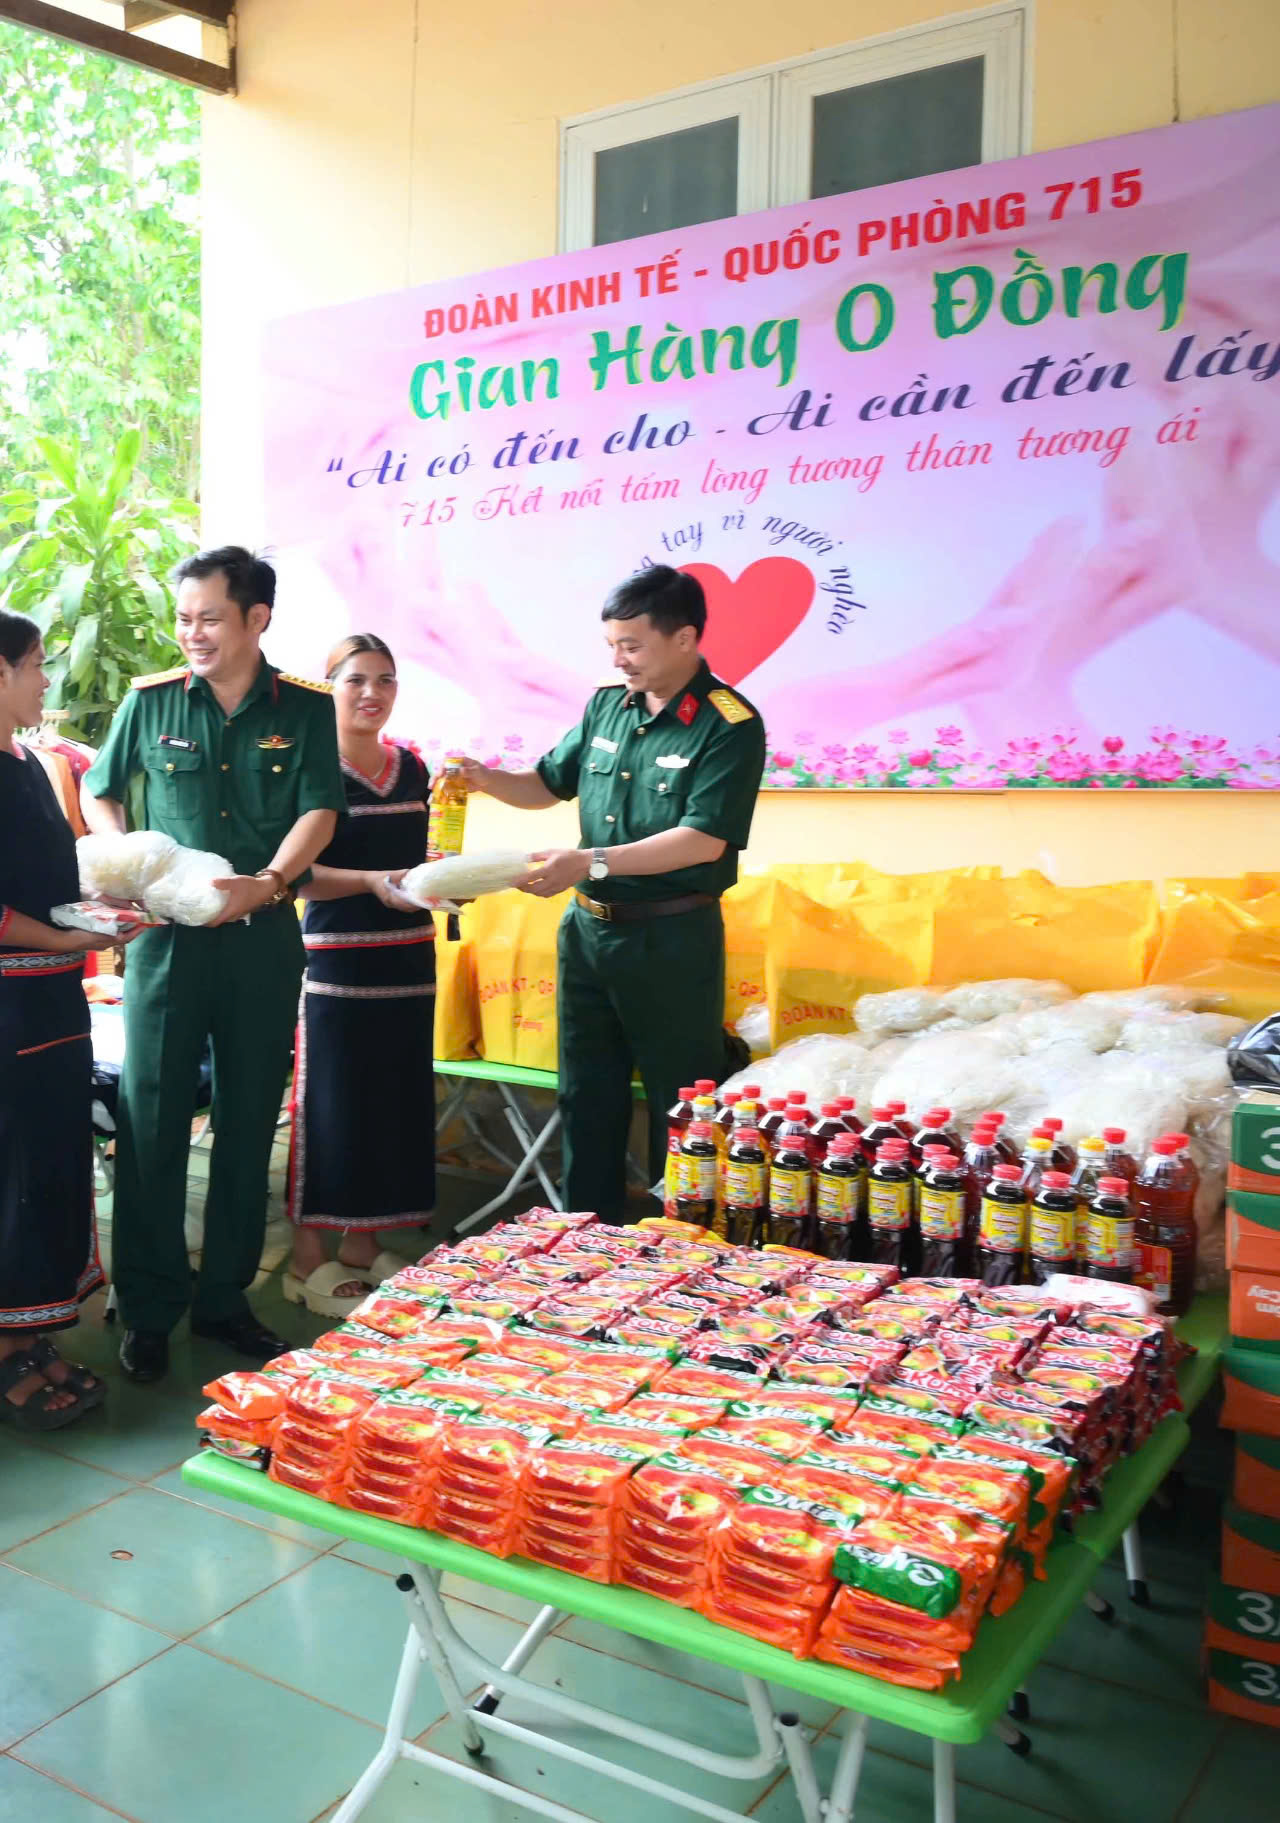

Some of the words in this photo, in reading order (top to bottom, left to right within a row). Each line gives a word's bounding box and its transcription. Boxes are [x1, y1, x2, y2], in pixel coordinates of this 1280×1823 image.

[424, 293, 519, 338] ĐOÀN
[531, 271, 621, 319] KINH
[634, 248, 683, 298] TẾ
[724, 222, 841, 283] QUỐC
[858, 191, 1027, 257] PHÒNG
[1044, 168, 1143, 221] 715
[409, 355, 561, 421] Gian
[589, 318, 800, 391] Hàng
[932, 248, 1190, 339] Đồng
[427, 443, 477, 479] có
[492, 431, 584, 469] đến
[604, 413, 696, 455] cho
[747, 388, 837, 435] Ai
[858, 374, 977, 422] cần
[1001, 352, 1137, 403] đến
[1164, 329, 1280, 382] lấy
[400, 497, 458, 527] 715
[701, 458, 770, 504] lòng
[906, 433, 993, 473] thân
[1017, 420, 1131, 468] tương
[1156, 406, 1203, 444] ái
[661, 521, 704, 552] tay
